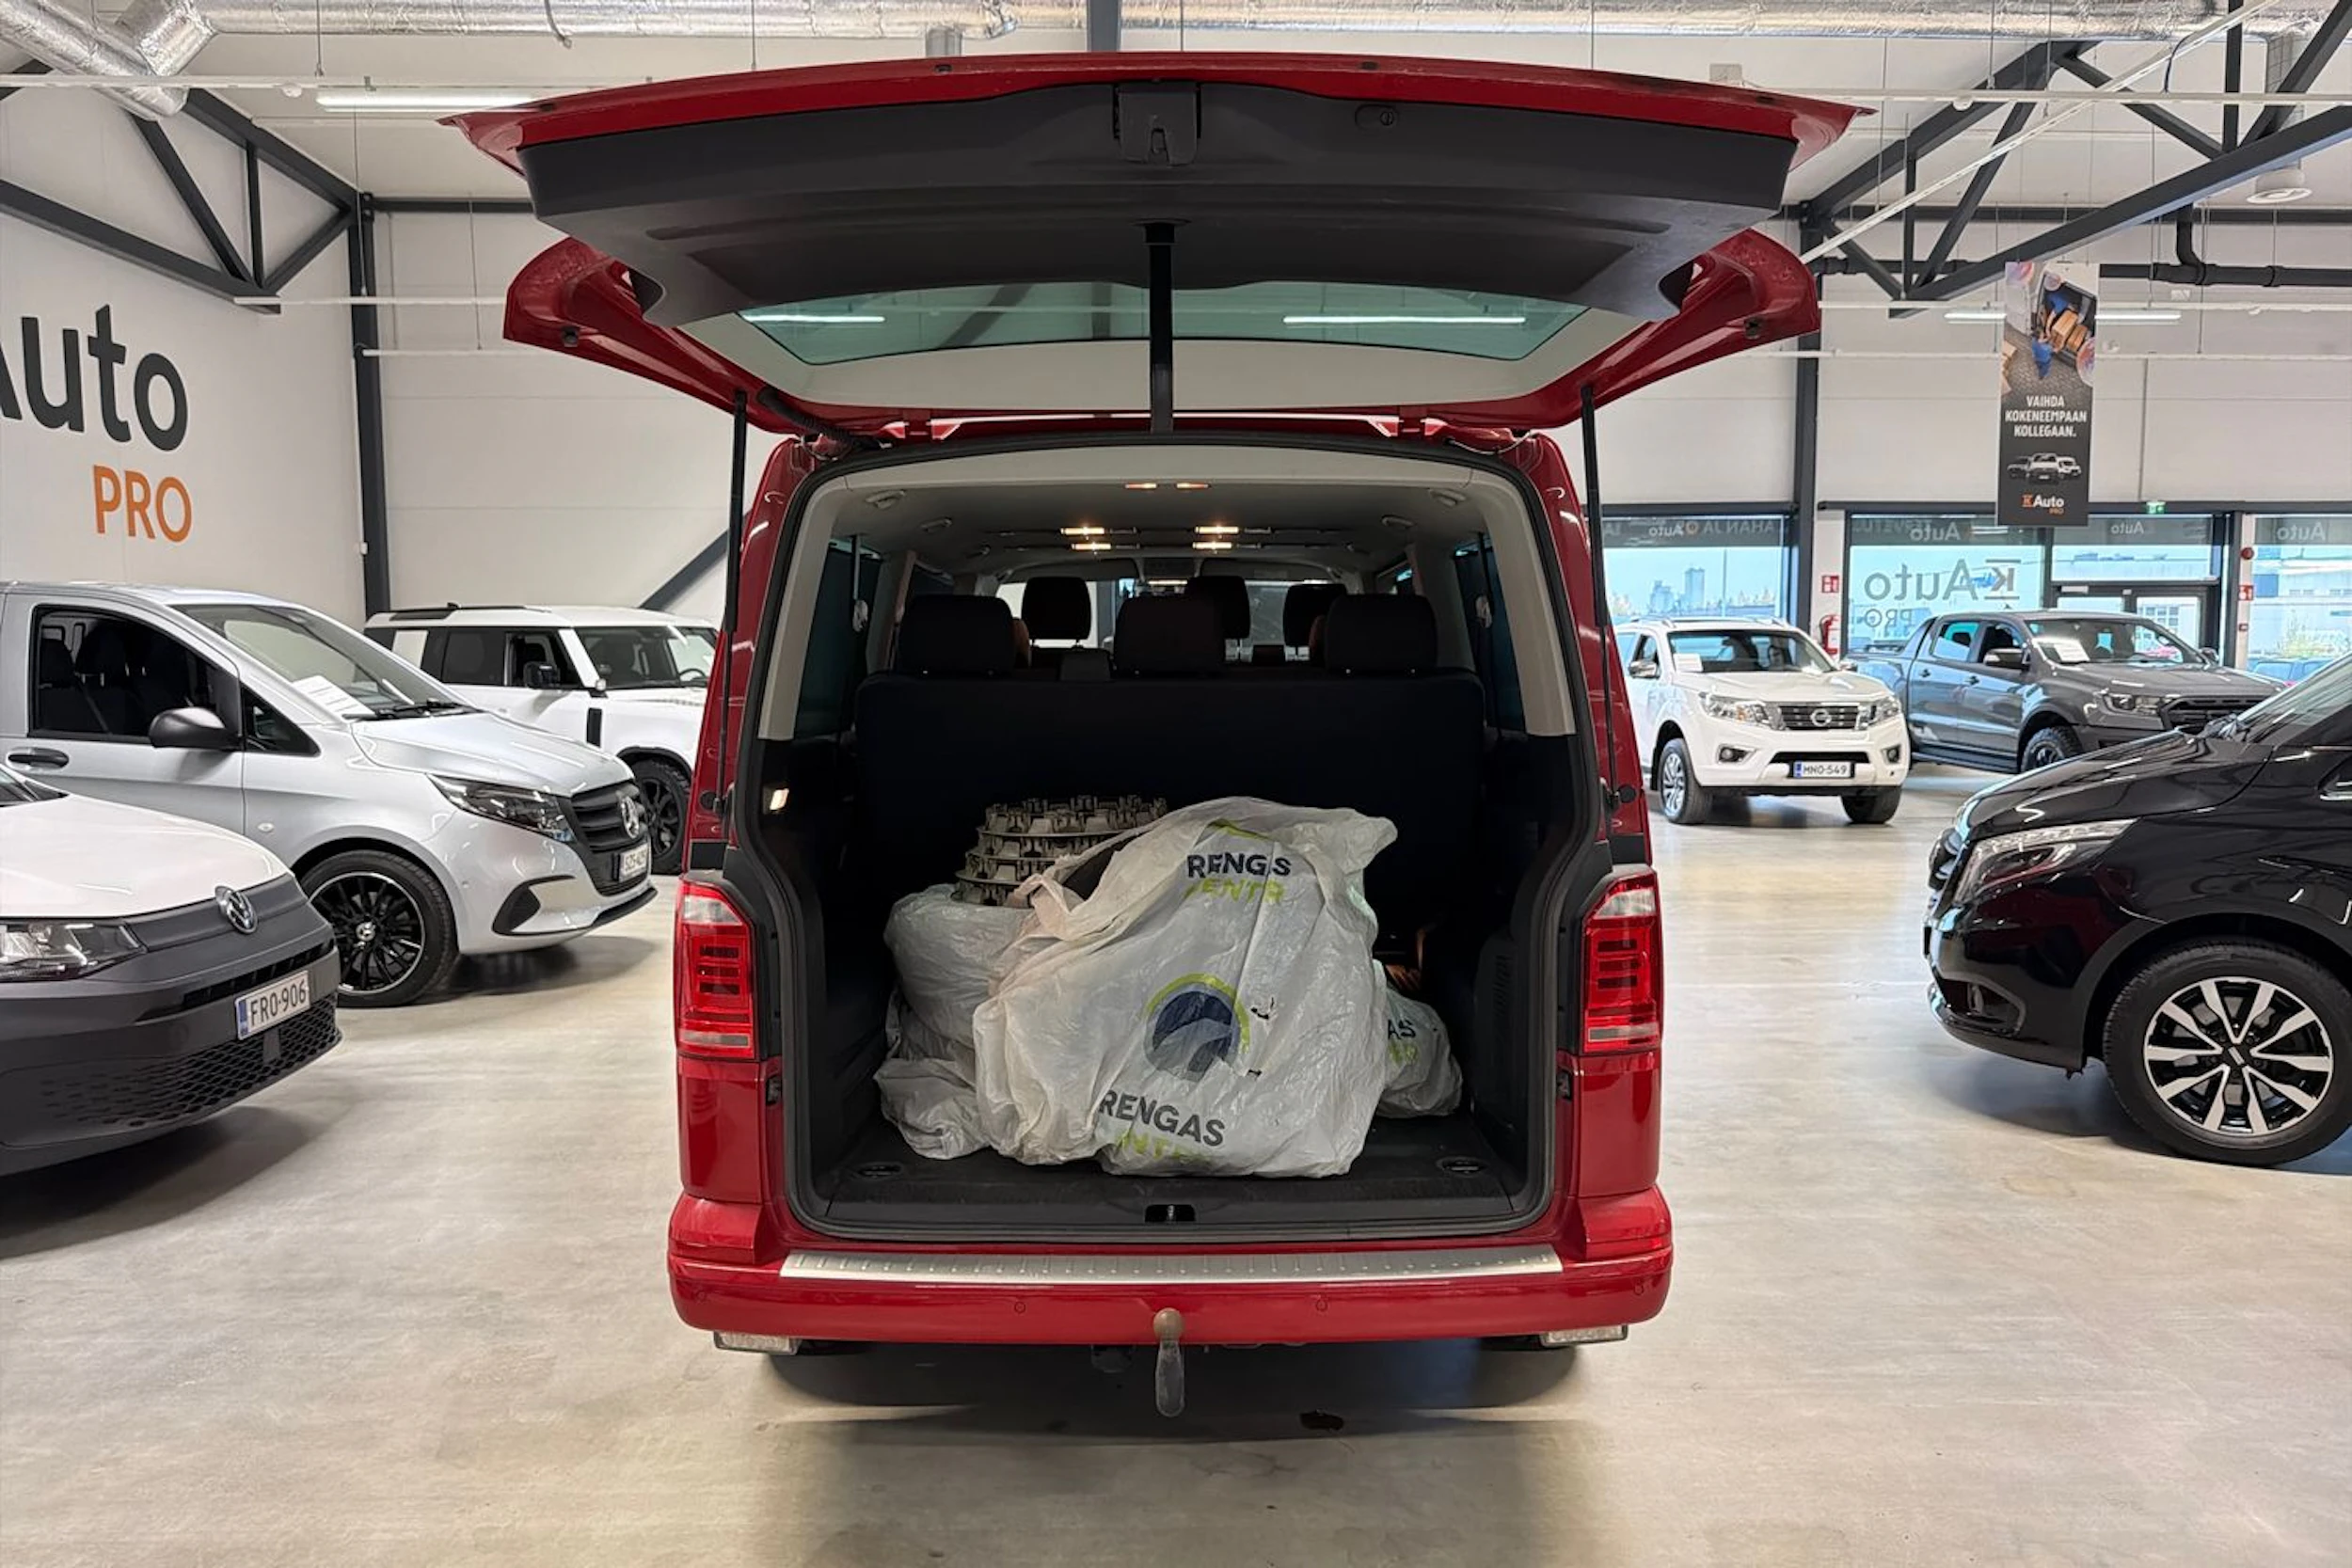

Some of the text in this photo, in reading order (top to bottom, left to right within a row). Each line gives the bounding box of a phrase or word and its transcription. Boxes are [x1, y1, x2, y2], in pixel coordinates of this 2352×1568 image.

[2026, 395, 2065, 407] VAIHDA
[2005, 409, 2088, 422] KOKENEEMPAAN
[2014, 424, 2077, 437] KOLLEGAAN.
[93, 466, 192, 543] PRO
[2033, 494, 2065, 507] Auto
[250, 979, 306, 1027] FRO-906
[1098, 1089, 1225, 1147] RENGAS
